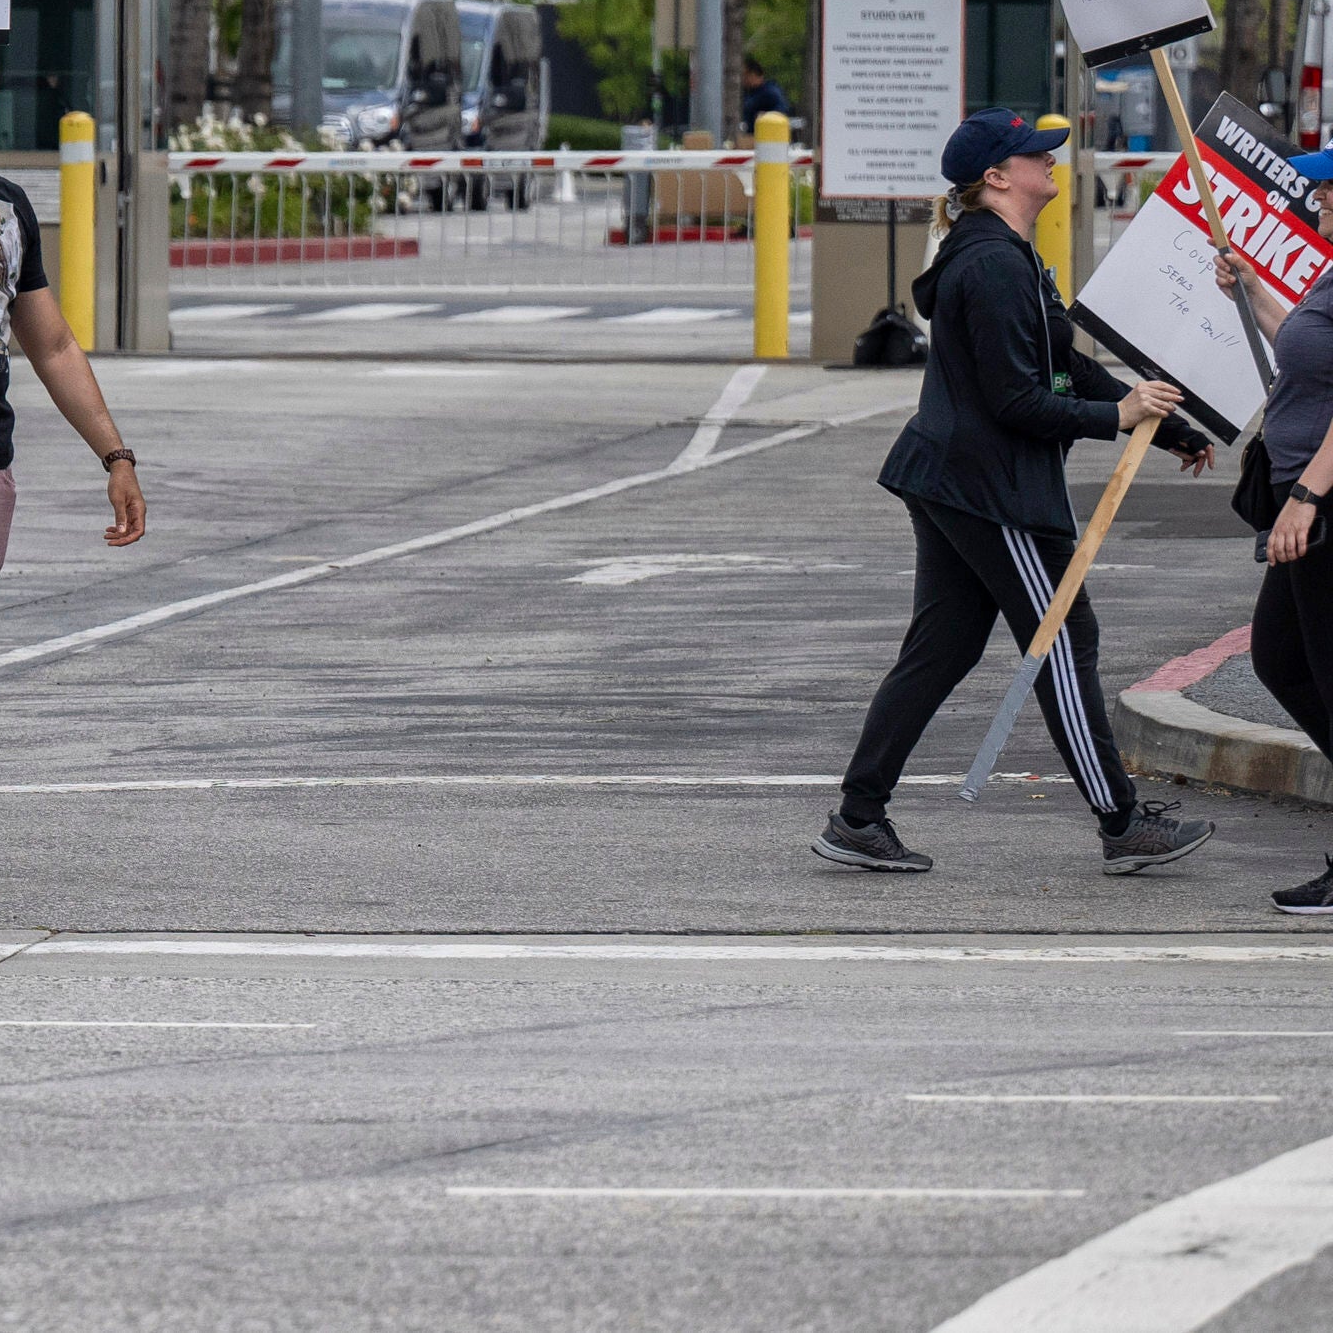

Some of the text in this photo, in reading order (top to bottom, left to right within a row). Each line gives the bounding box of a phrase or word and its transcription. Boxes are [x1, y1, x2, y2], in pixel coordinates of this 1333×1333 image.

[860, 9, 926, 21] STUDIO GATE
[1215, 115, 1310, 199] WRITERS
[1265, 190, 1290, 213] ON
[1169, 292, 1189, 315] The
